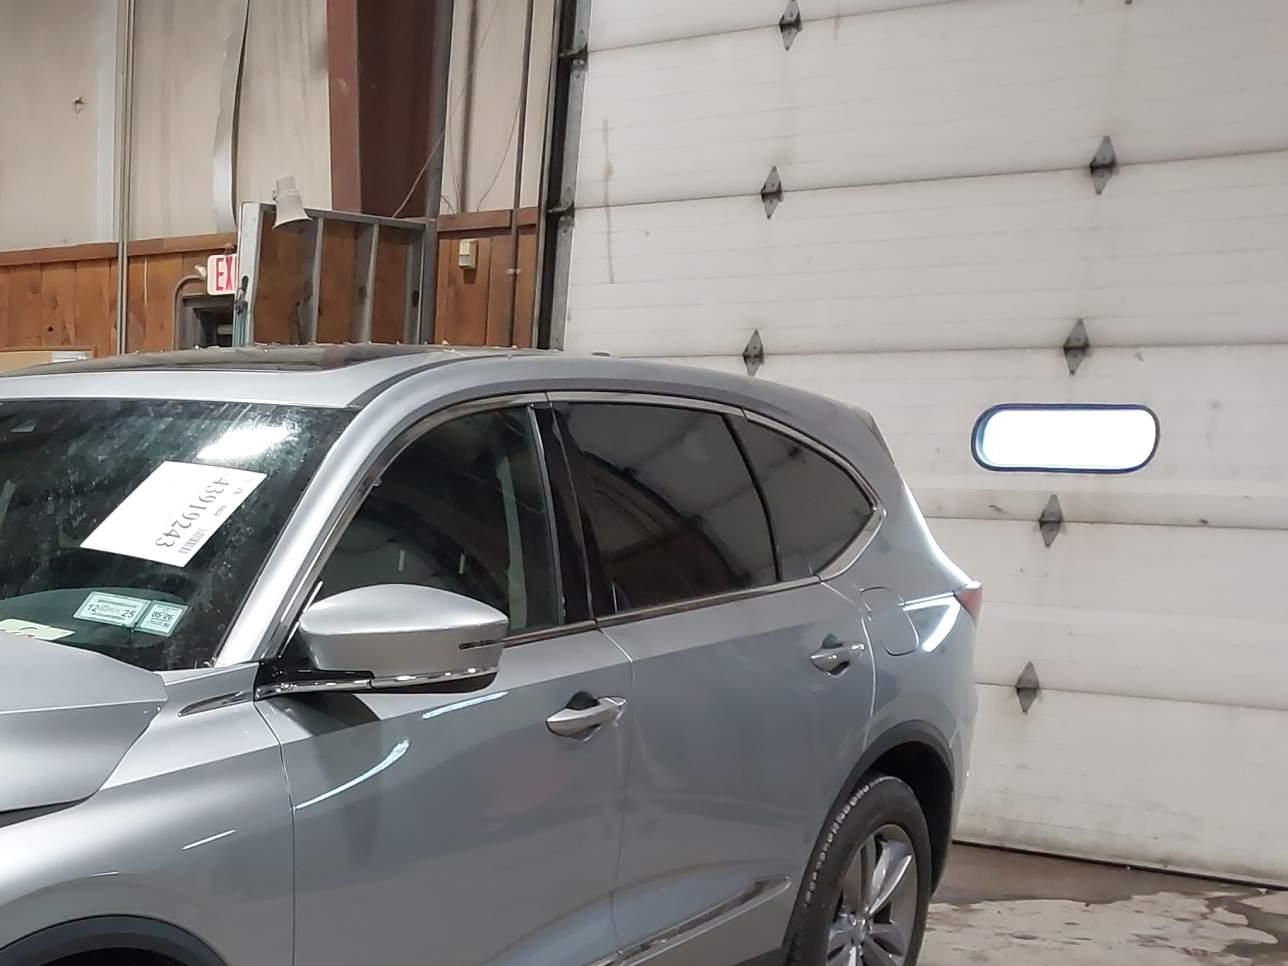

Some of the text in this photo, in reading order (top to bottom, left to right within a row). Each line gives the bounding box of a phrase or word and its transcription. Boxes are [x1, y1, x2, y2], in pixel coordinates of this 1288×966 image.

[216, 256, 238, 291] EXI
[155, 477, 230, 548] 43919243
[121, 609, 138, 619] 25
